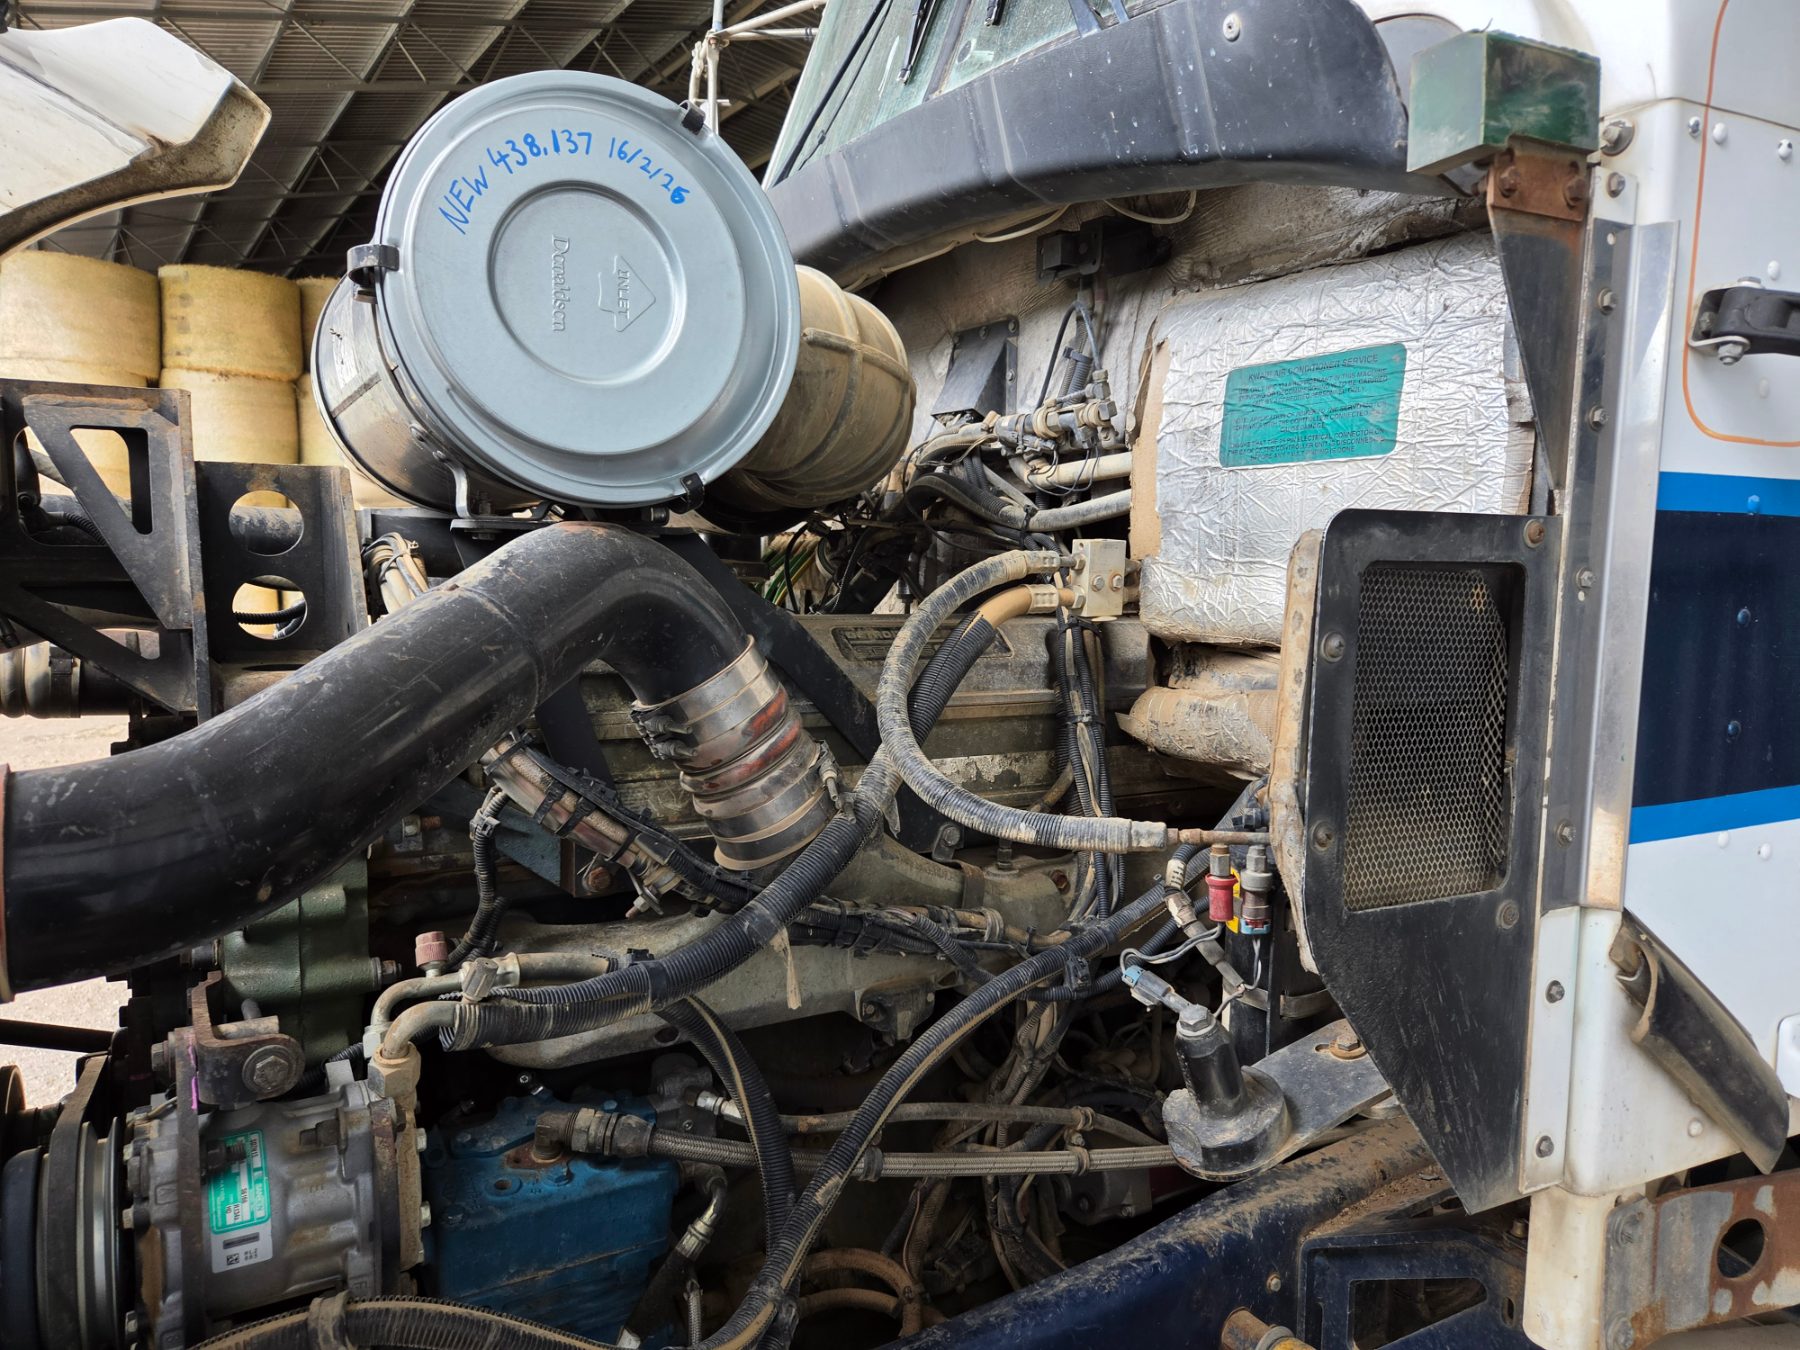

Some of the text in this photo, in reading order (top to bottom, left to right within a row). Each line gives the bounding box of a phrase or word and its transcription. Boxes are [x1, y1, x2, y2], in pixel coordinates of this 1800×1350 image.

[438, 165, 489, 235] NEW
[487, 128, 593, 175] 438.137
[552, 233, 571, 333] Donaldson
[616, 268, 631, 320] INLET
[1342, 353, 1378, 367] SERVICE
